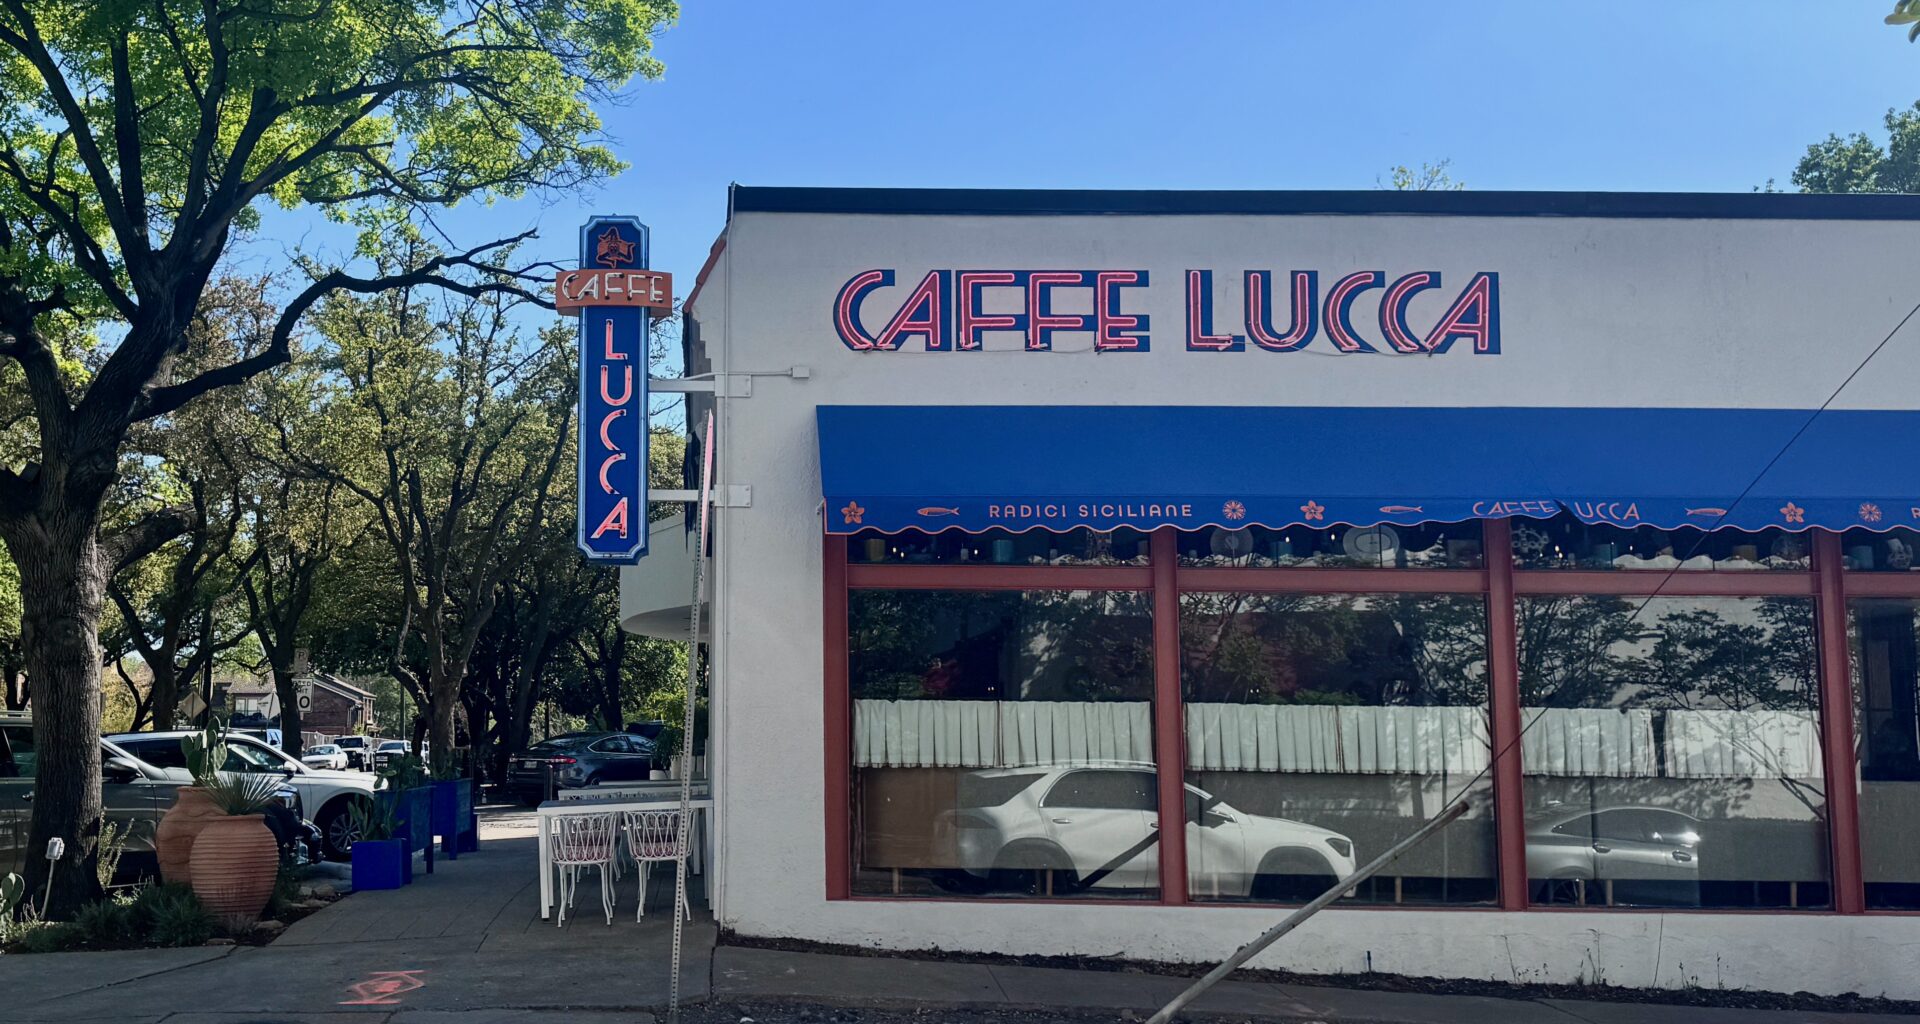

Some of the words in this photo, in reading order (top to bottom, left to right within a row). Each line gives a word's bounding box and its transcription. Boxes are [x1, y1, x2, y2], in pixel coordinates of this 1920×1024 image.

[562, 272, 664, 303] CAFFE
[833, 269, 1150, 352] CAFFE
[1186, 270, 1501, 354] LUCCA
[590, 318, 632, 538] LUCCA
[989, 504, 1067, 518] RADICI
[1078, 504, 1193, 517] SICILIANE
[1472, 501, 1555, 516] CAFFE
[1574, 501, 1640, 521] UCCA
[299, 695, 310, 709] 0
